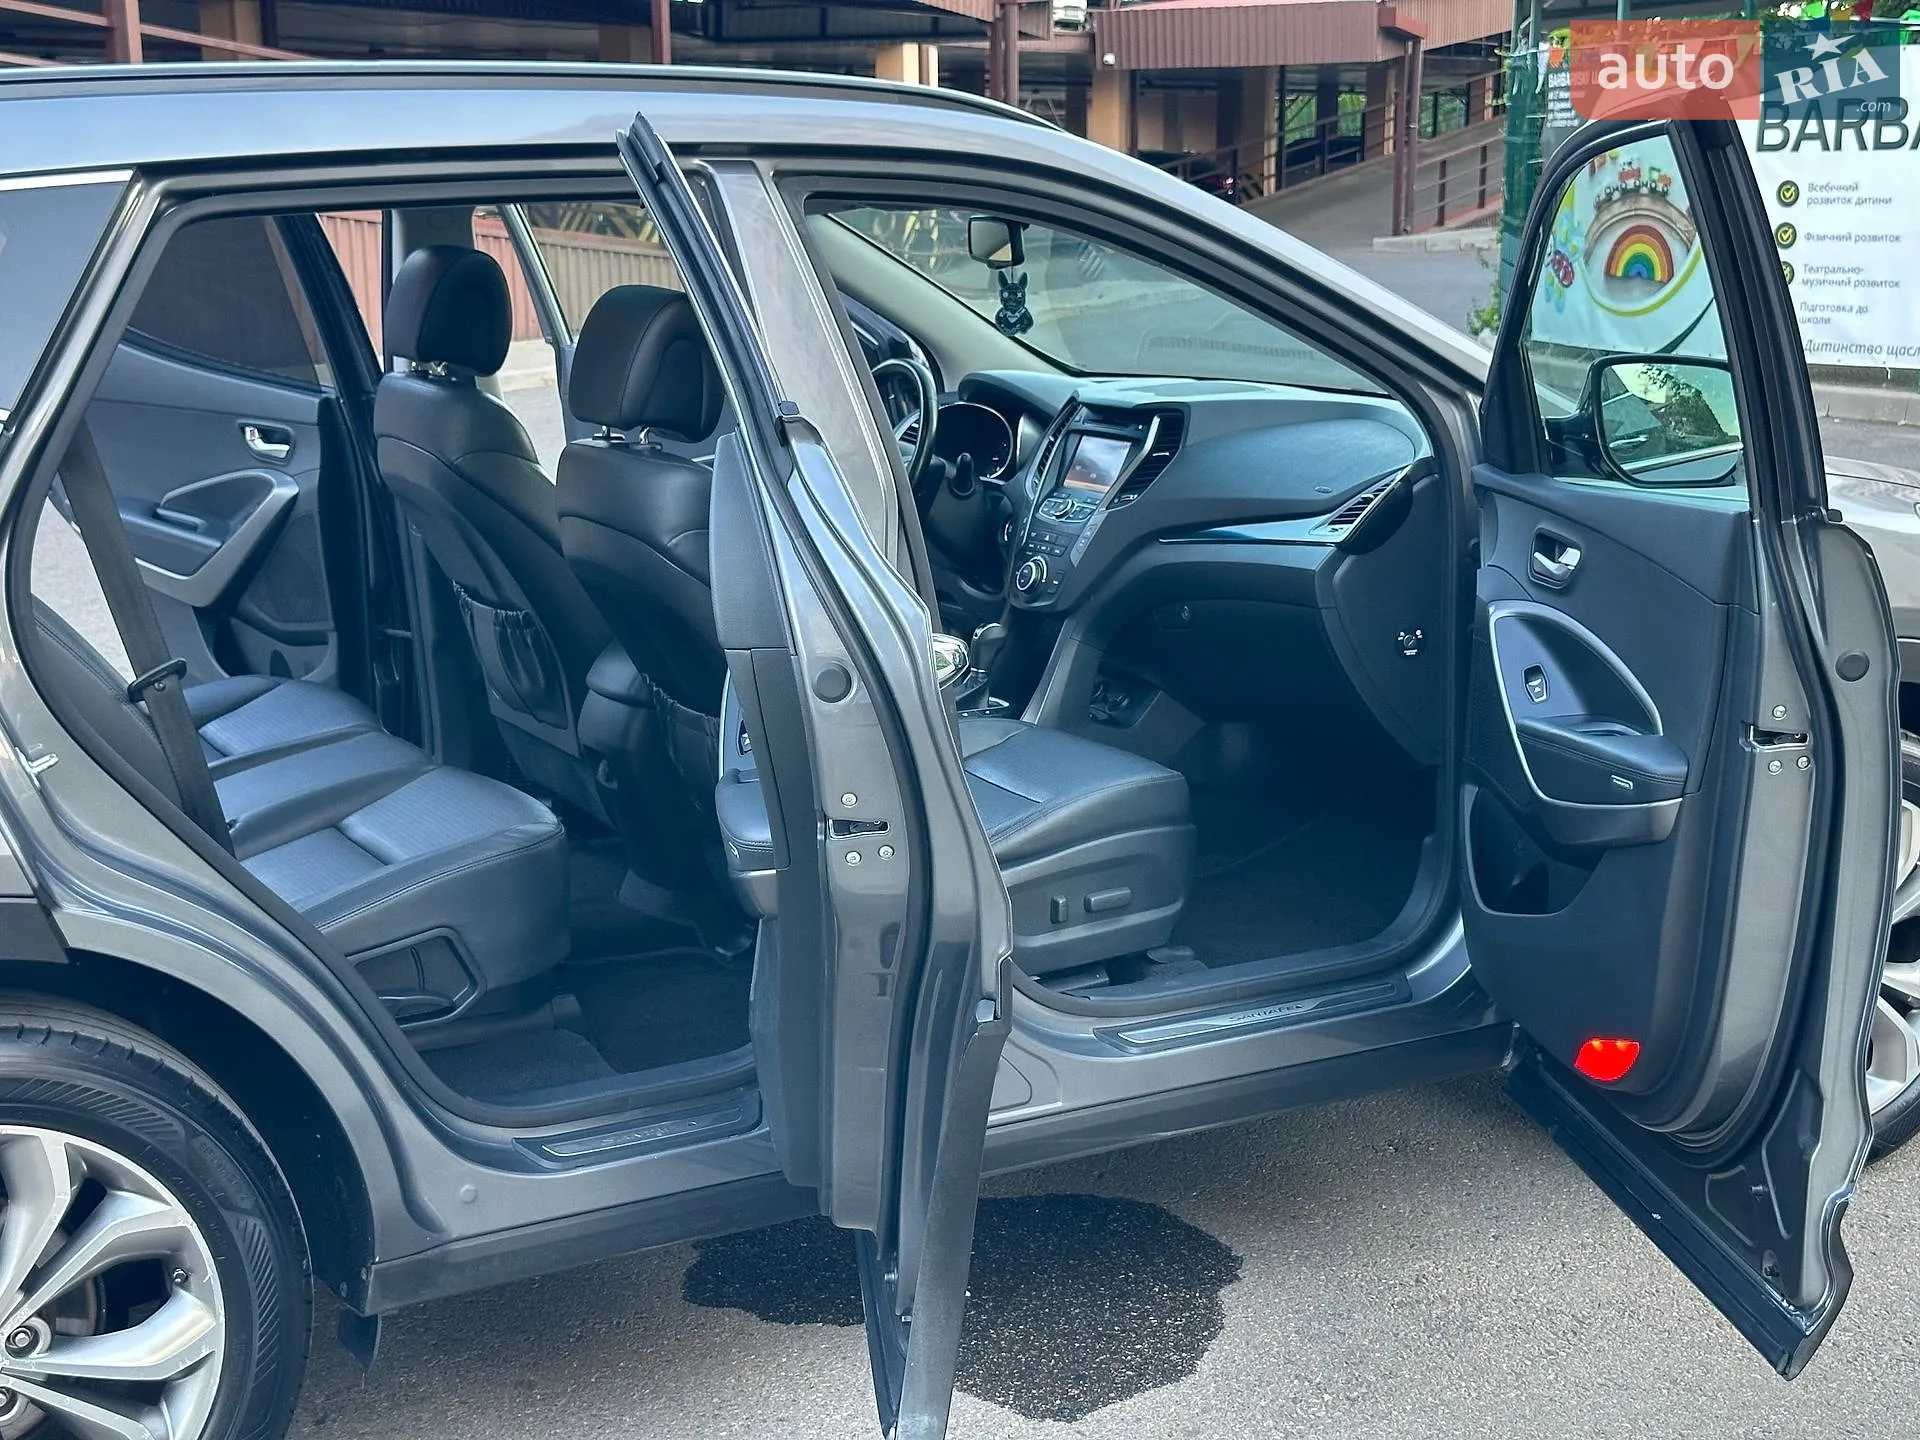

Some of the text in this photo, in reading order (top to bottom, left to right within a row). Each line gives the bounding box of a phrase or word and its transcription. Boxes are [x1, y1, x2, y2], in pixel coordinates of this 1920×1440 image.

[1806, 196, 1893, 208] розвиток дитини
[1803, 231, 1902, 245] Фізичний розвиток
[1803, 263, 1865, 275] Театрально-
[1801, 276, 1901, 290] музичний розвиток
[1799, 301, 1869, 315] Підготовка до
[1799, 316, 1832, 325] школи
[1804, 339, 1883, 356] Дитинство
